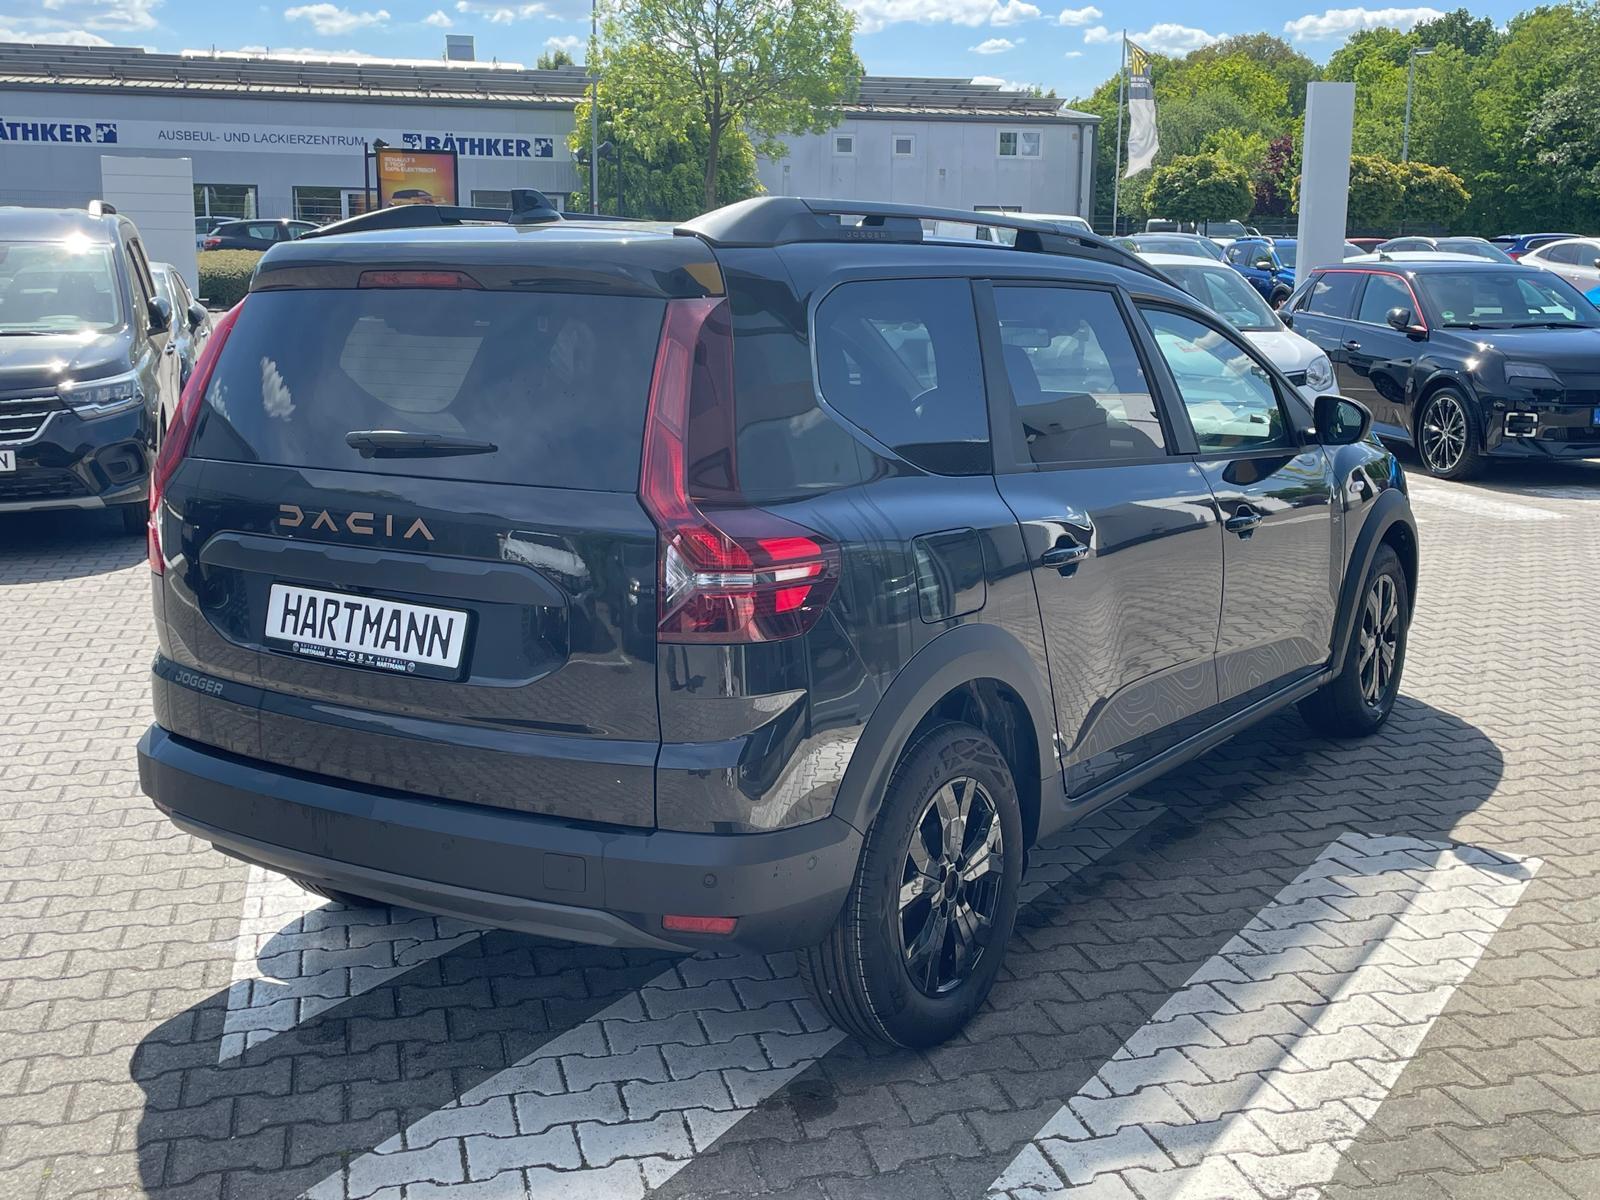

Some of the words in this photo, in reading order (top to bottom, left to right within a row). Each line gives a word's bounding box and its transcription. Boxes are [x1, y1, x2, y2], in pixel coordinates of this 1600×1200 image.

[158, 130, 220, 142] AUSBEUL-
[224, 132, 250, 143] UND
[254, 133, 364, 146] LACKIERZENTRUM
[425, 133, 531, 157] BÄTHKER
[279, 504, 435, 541] DACIA
[280, 592, 454, 660] HARTMANN
[376, 661, 406, 671] HARTMANN
[175, 670, 224, 695] JOGGER
